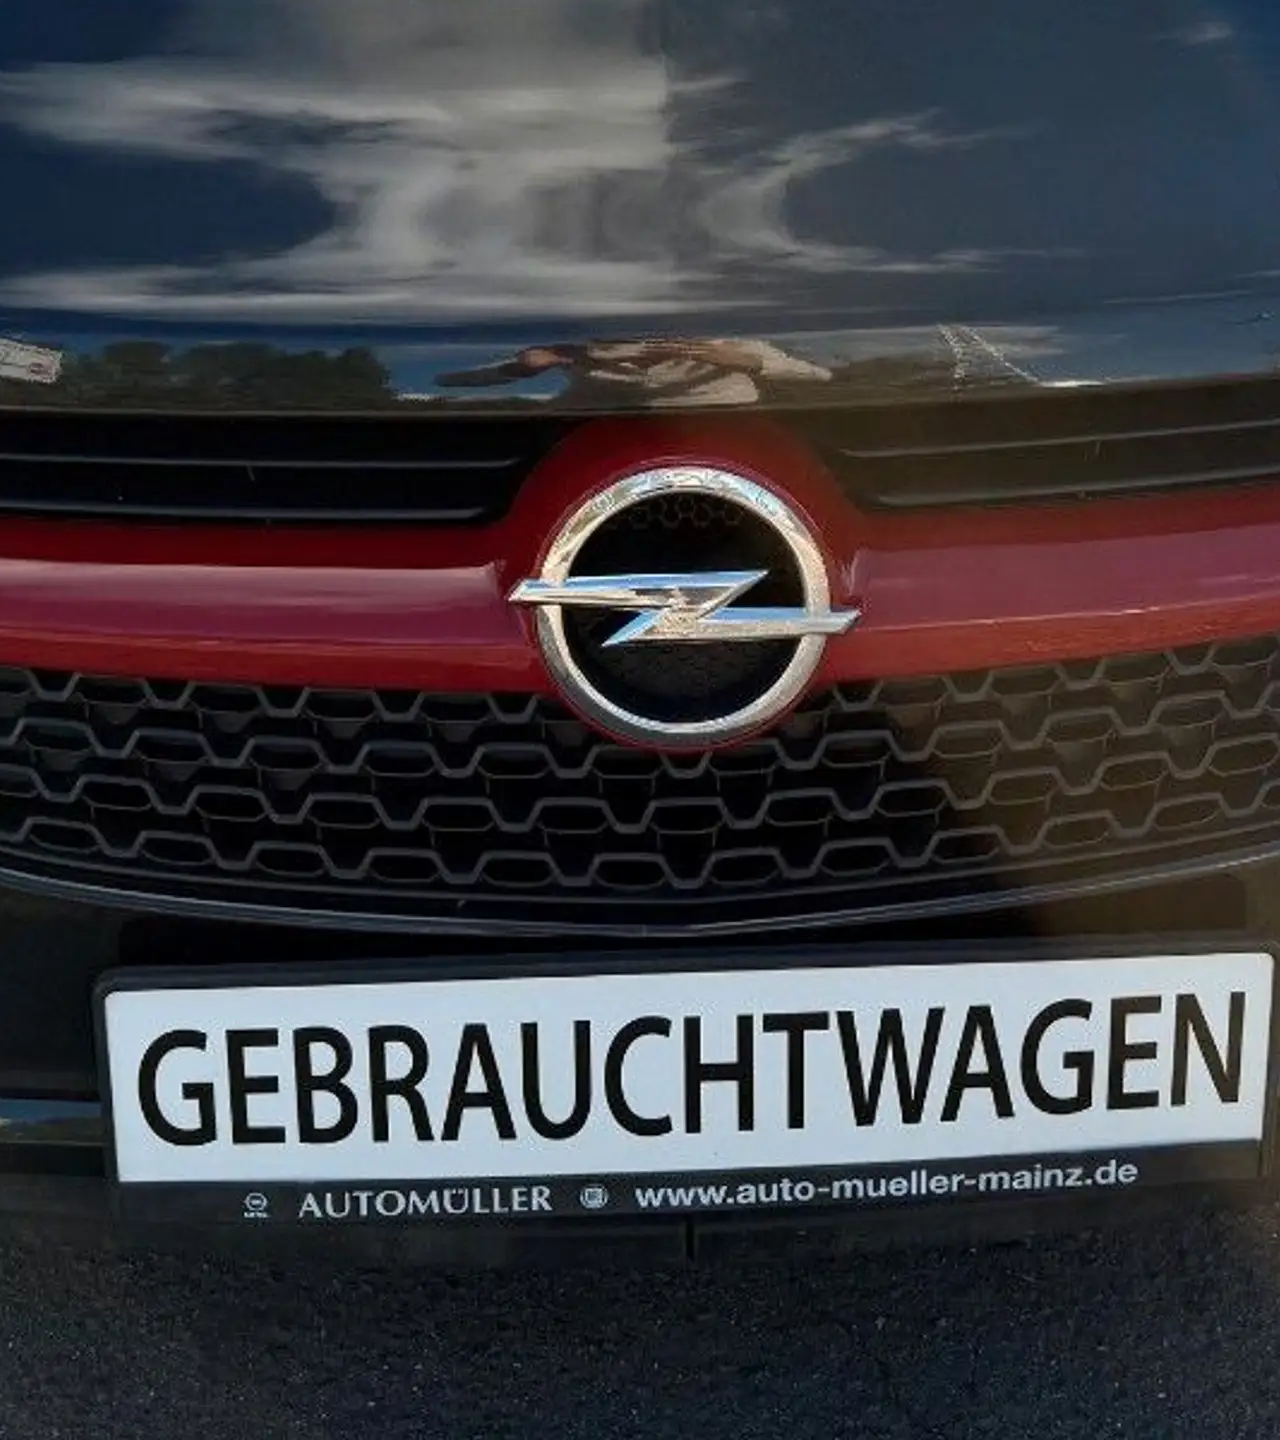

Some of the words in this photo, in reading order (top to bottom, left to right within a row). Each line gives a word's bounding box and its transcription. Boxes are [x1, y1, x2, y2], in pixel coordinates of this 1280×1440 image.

[136, 990, 1247, 1147] GEBRAUCHTWAGEN
[298, 1185, 553, 1219] AUTOMÜLLER
[635, 1158, 1139, 1209] www.auto-mueller-mainz.de
